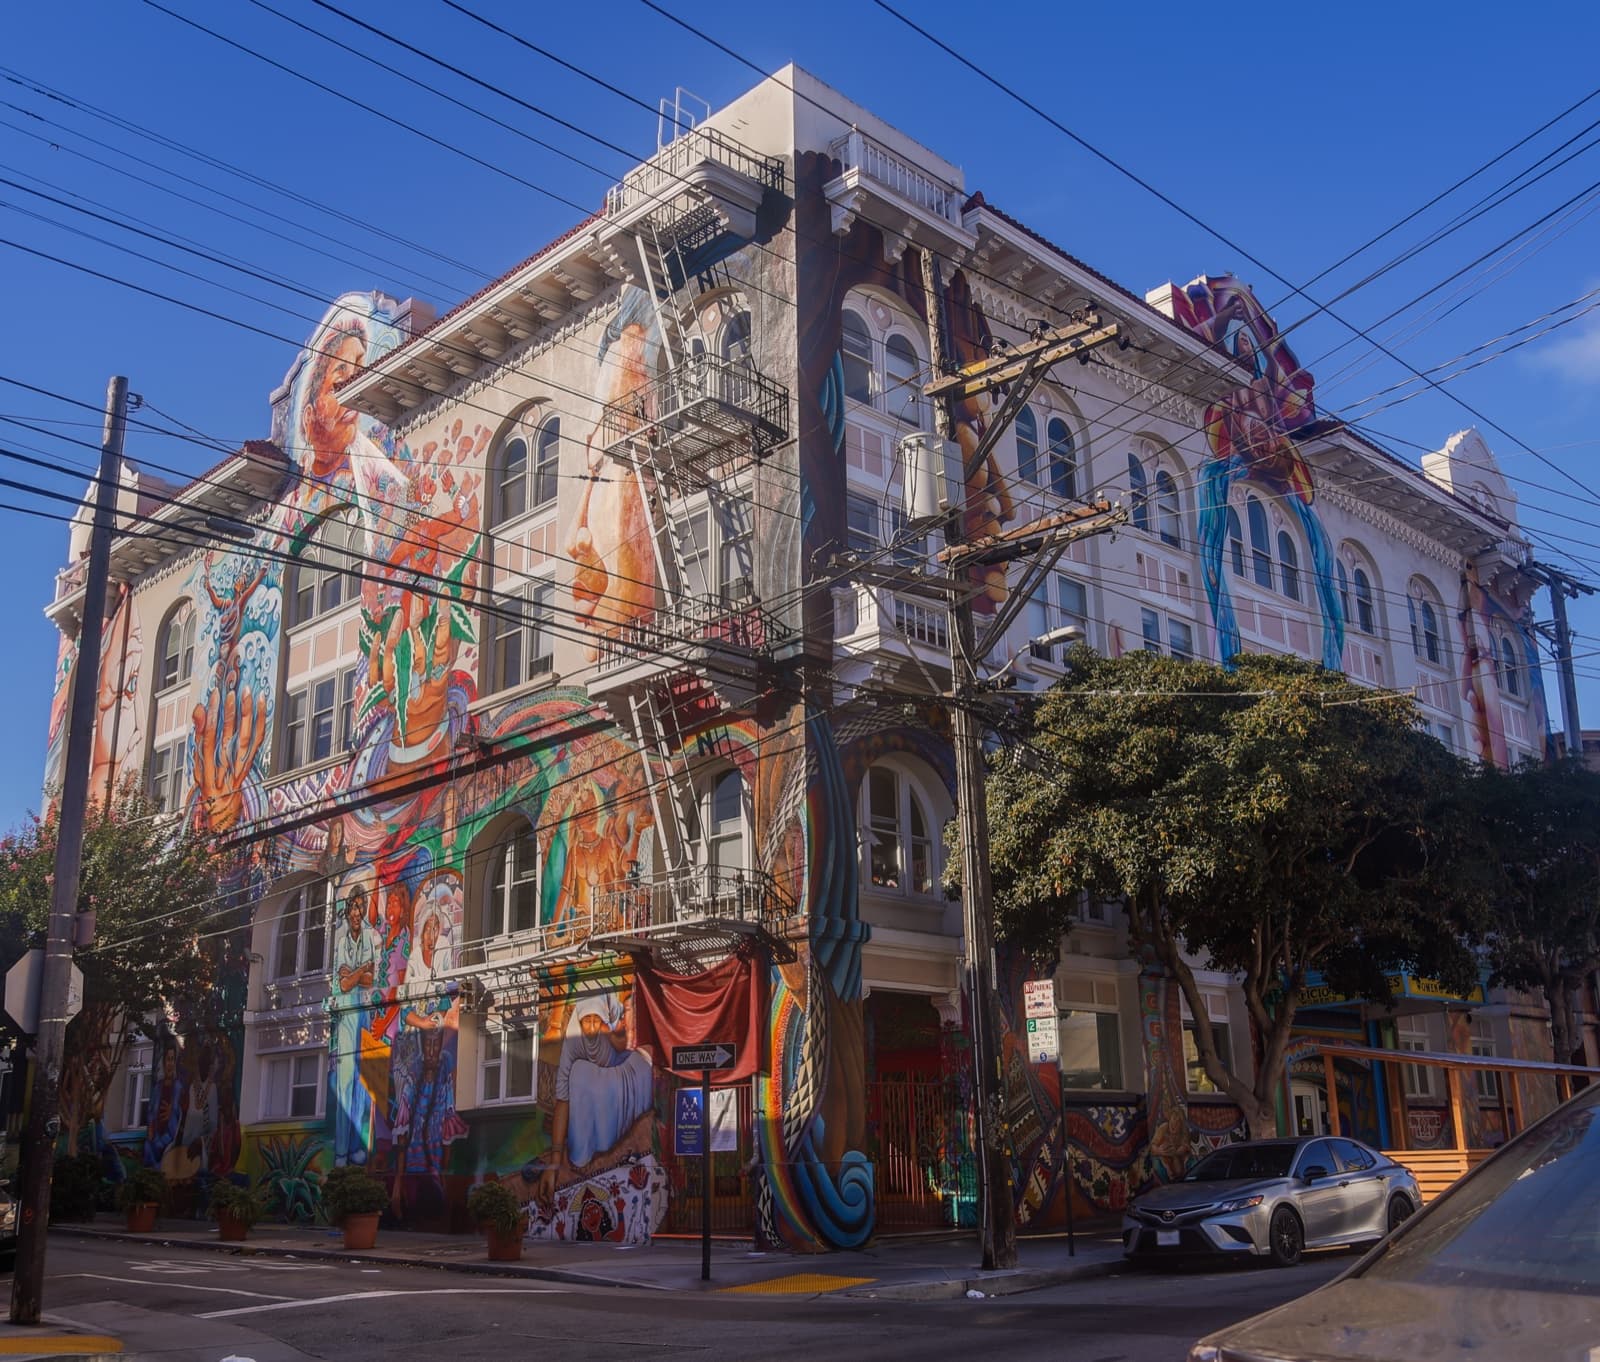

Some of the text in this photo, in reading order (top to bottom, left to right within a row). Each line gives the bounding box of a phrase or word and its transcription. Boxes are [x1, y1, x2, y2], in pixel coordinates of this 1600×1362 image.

[1025, 984, 1034, 993] NO
[1029, 1021, 1035, 1031] 2
[678, 1052, 716, 1064] ONE WAY
